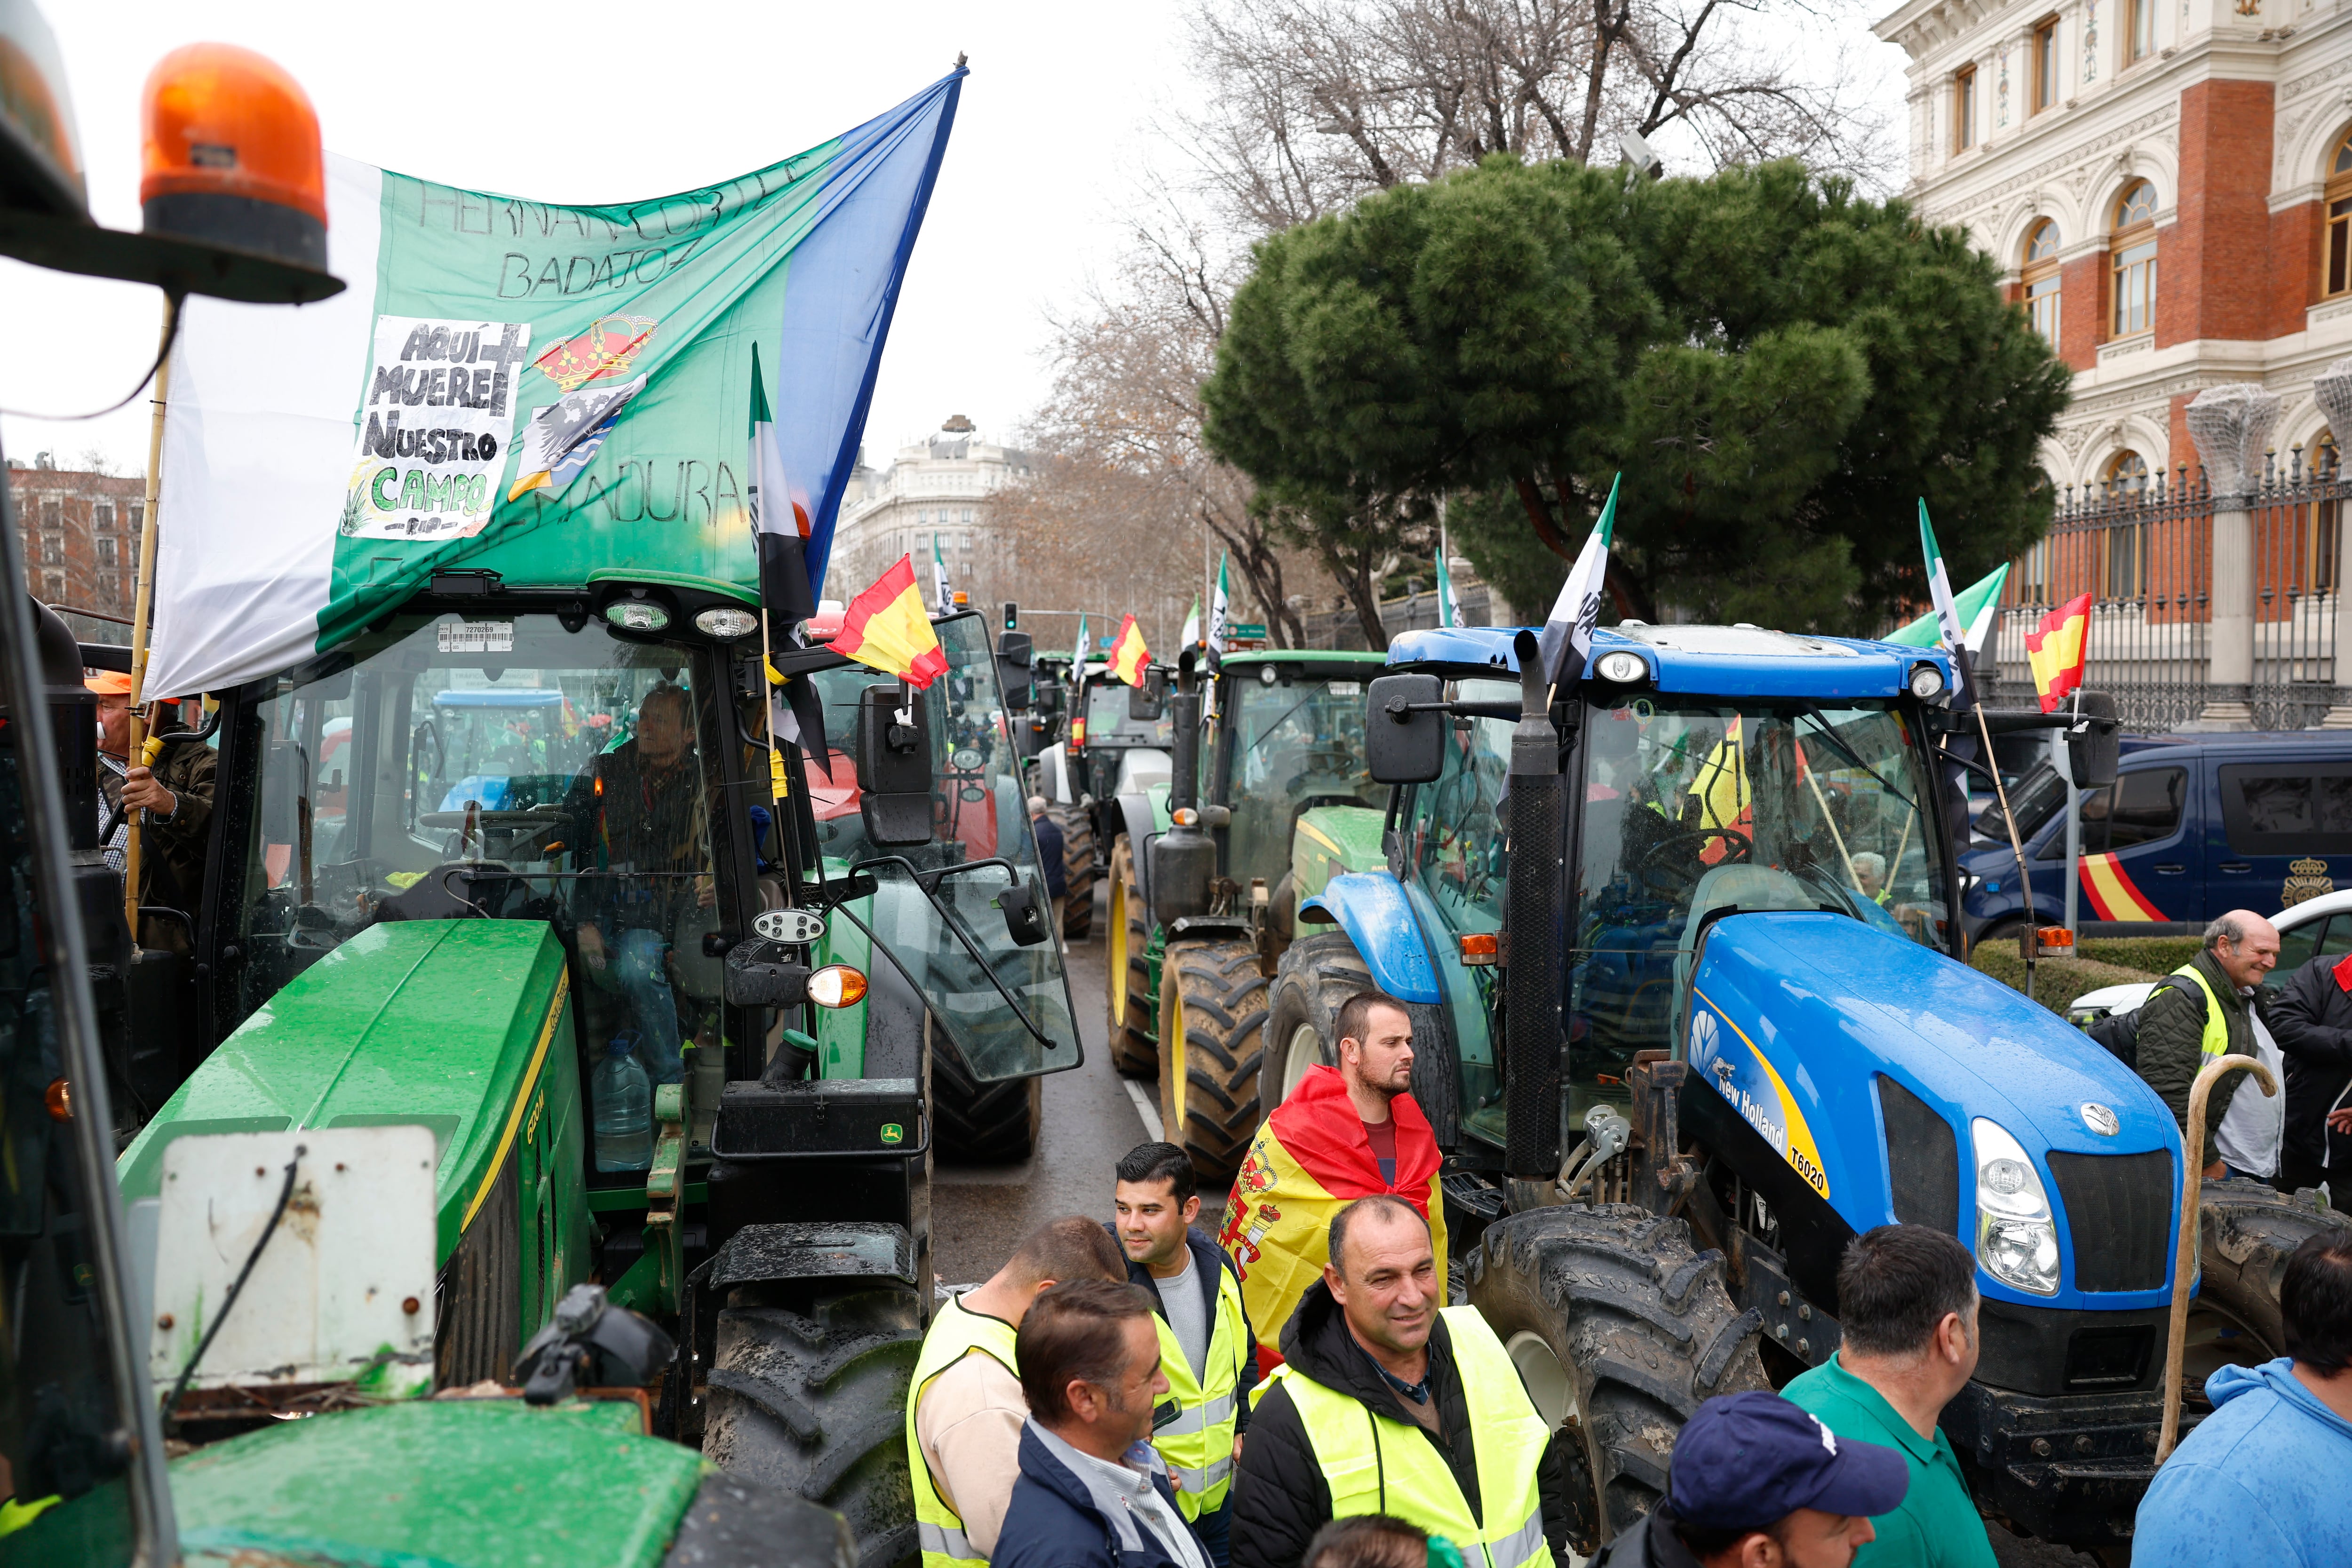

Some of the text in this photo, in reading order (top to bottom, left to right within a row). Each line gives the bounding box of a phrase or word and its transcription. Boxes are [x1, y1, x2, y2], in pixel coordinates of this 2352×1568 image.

[400, 323, 489, 363] AQUÍ
[369, 365, 492, 408] MUERE
[362, 410, 497, 464] NUESTRO
[371, 467, 487, 512] CAMPO
[1718, 1075, 1784, 1151] New Holland
[1791, 1146, 1824, 1191] T6020
